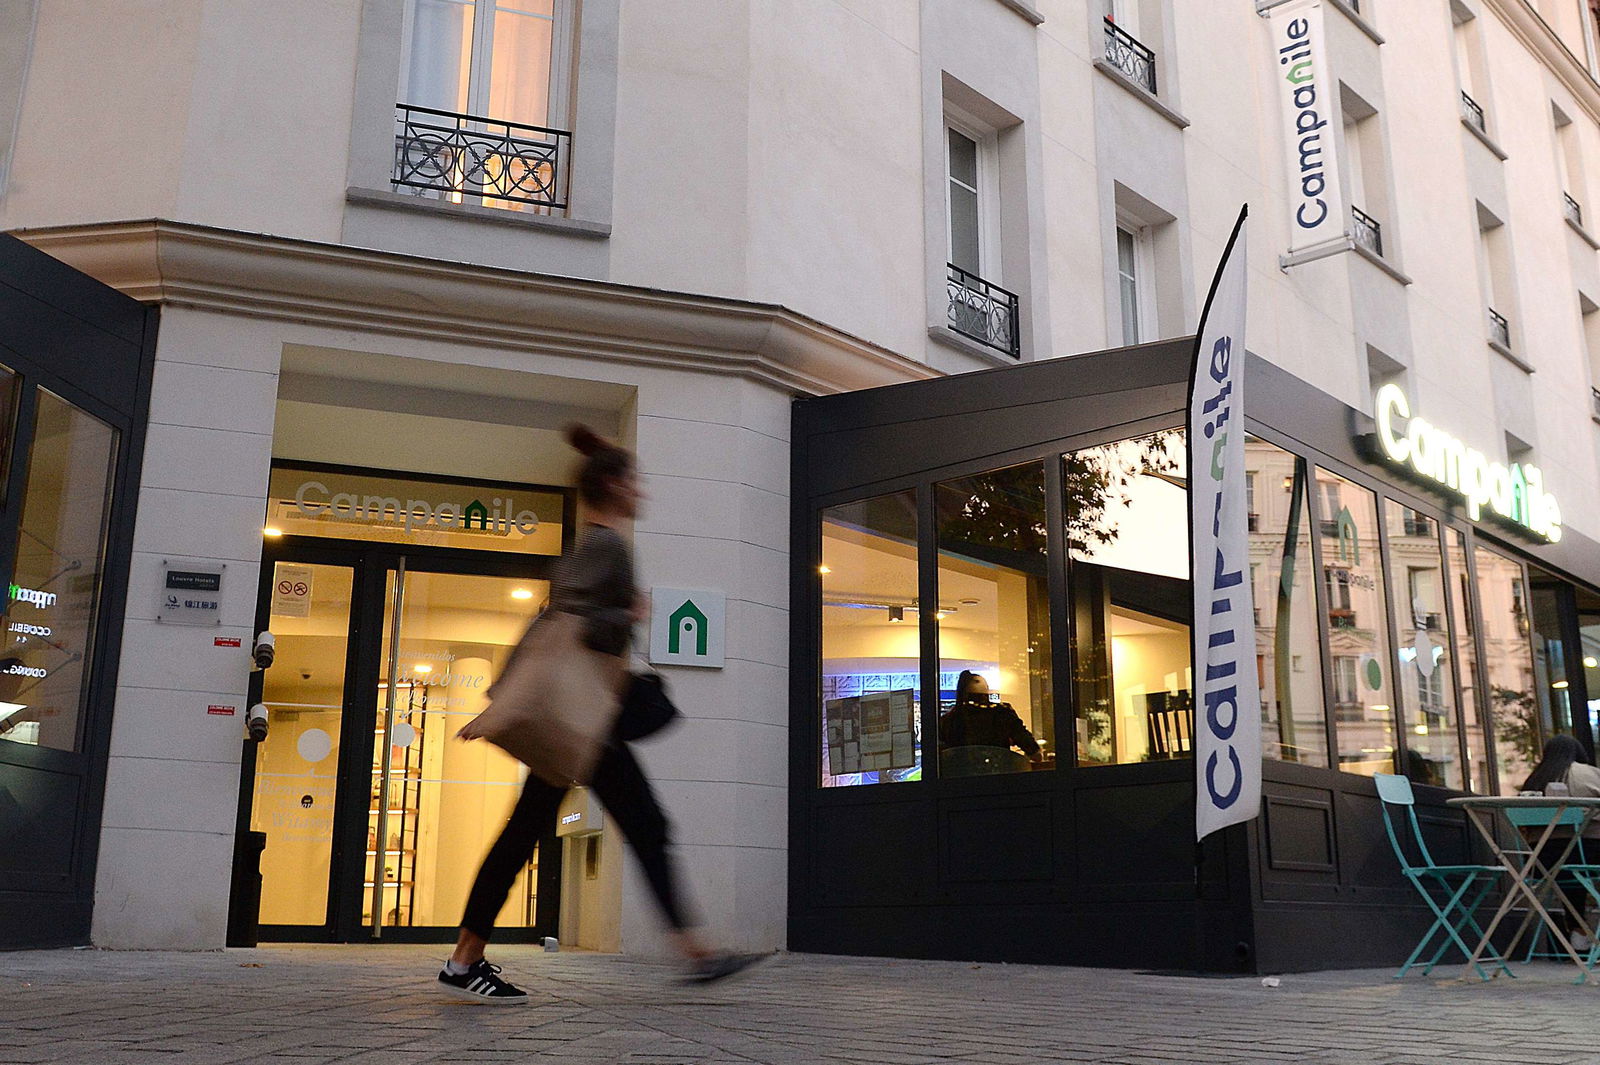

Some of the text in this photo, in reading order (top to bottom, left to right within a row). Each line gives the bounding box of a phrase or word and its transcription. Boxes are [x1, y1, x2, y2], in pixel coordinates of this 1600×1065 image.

[1279, 19, 1327, 229] Campanile
[295, 481, 539, 535] Campanile
[1375, 383, 1562, 543] Campanile
